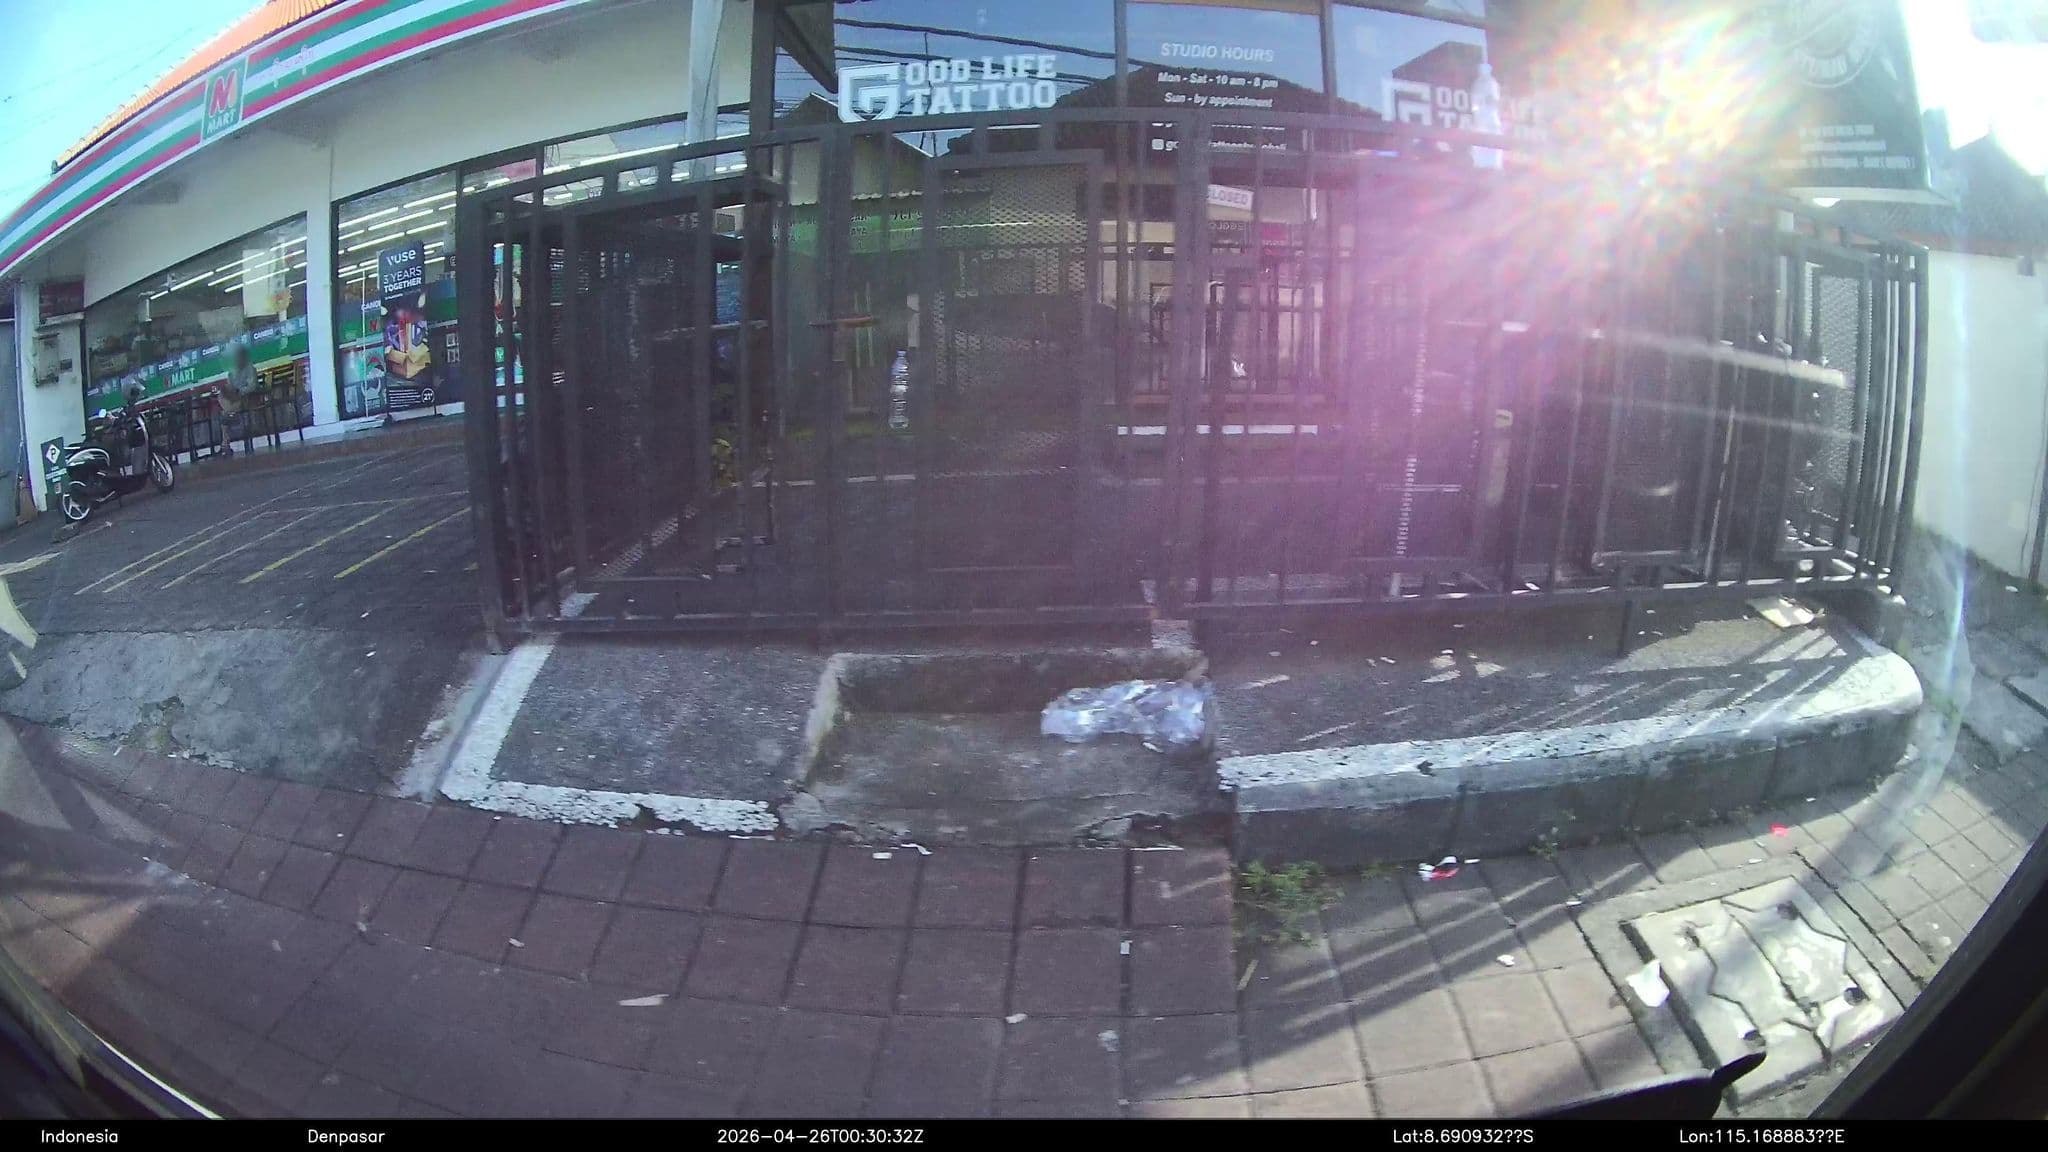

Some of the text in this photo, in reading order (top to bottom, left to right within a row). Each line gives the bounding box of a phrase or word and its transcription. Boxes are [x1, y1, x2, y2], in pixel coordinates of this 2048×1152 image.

[1161, 43, 1275, 62] STUDIO HOURS
[980, 54, 1057, 80] LIFE
[1158, 72, 1181, 82] Mon
[1190, 73, 1207, 83] Sat
[1216, 75, 1228, 85] 10
[1230, 77, 1245, 86] am
[1262, 79, 1278, 89] pm
[905, 80, 1056, 116] TATTOO
[1164, 92, 1186, 103] Sun
[1194, 94, 1208, 106] by
[1209, 96, 1273, 108] appointment
[207, 108, 236, 135] MART
[391, 266, 422, 282] YEARS
[383, 277, 422, 293] TOGETHER
[171, 368, 196, 387] MART
